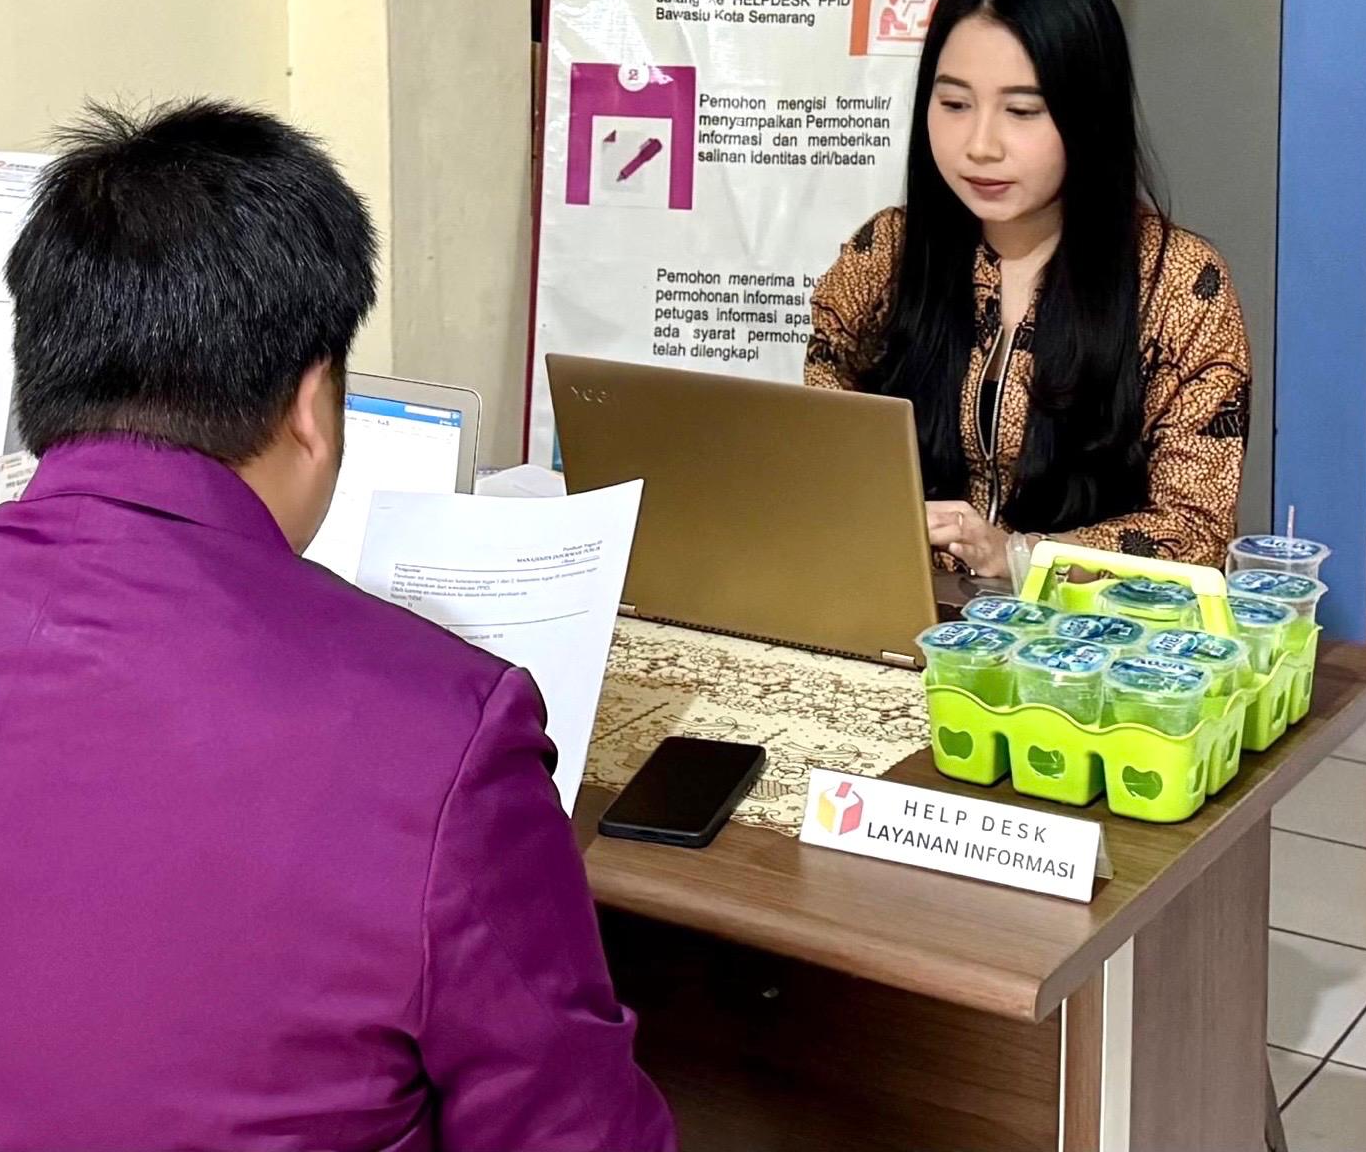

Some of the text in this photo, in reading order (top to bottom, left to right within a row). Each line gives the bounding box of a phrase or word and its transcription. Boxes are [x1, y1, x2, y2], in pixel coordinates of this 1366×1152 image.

[715, 10, 744, 22] Kota
[749, 10, 815, 26] Semarang
[699, 94, 891, 113] Pemohon mengisi formulir/
[699, 115, 890, 130] menyampaikan Permohonan
[698, 130, 891, 147] informasi dan memberikan
[698, 150, 875, 165] salinan identitas diri/badan
[657, 269, 720, 284] Pemohon
[729, 274, 794, 287] menerima
[656, 289, 805, 305] permohonan informasi
[655, 308, 812, 327] petugas informasi apa
[654, 325, 680, 337] ada
[693, 328, 735, 341] syarat
[653, 343, 759, 361] telah dilengkapi
[904, 800, 1047, 843] HELP DESK
[867, 822, 1075, 879] LAYANAN INFORMASI
